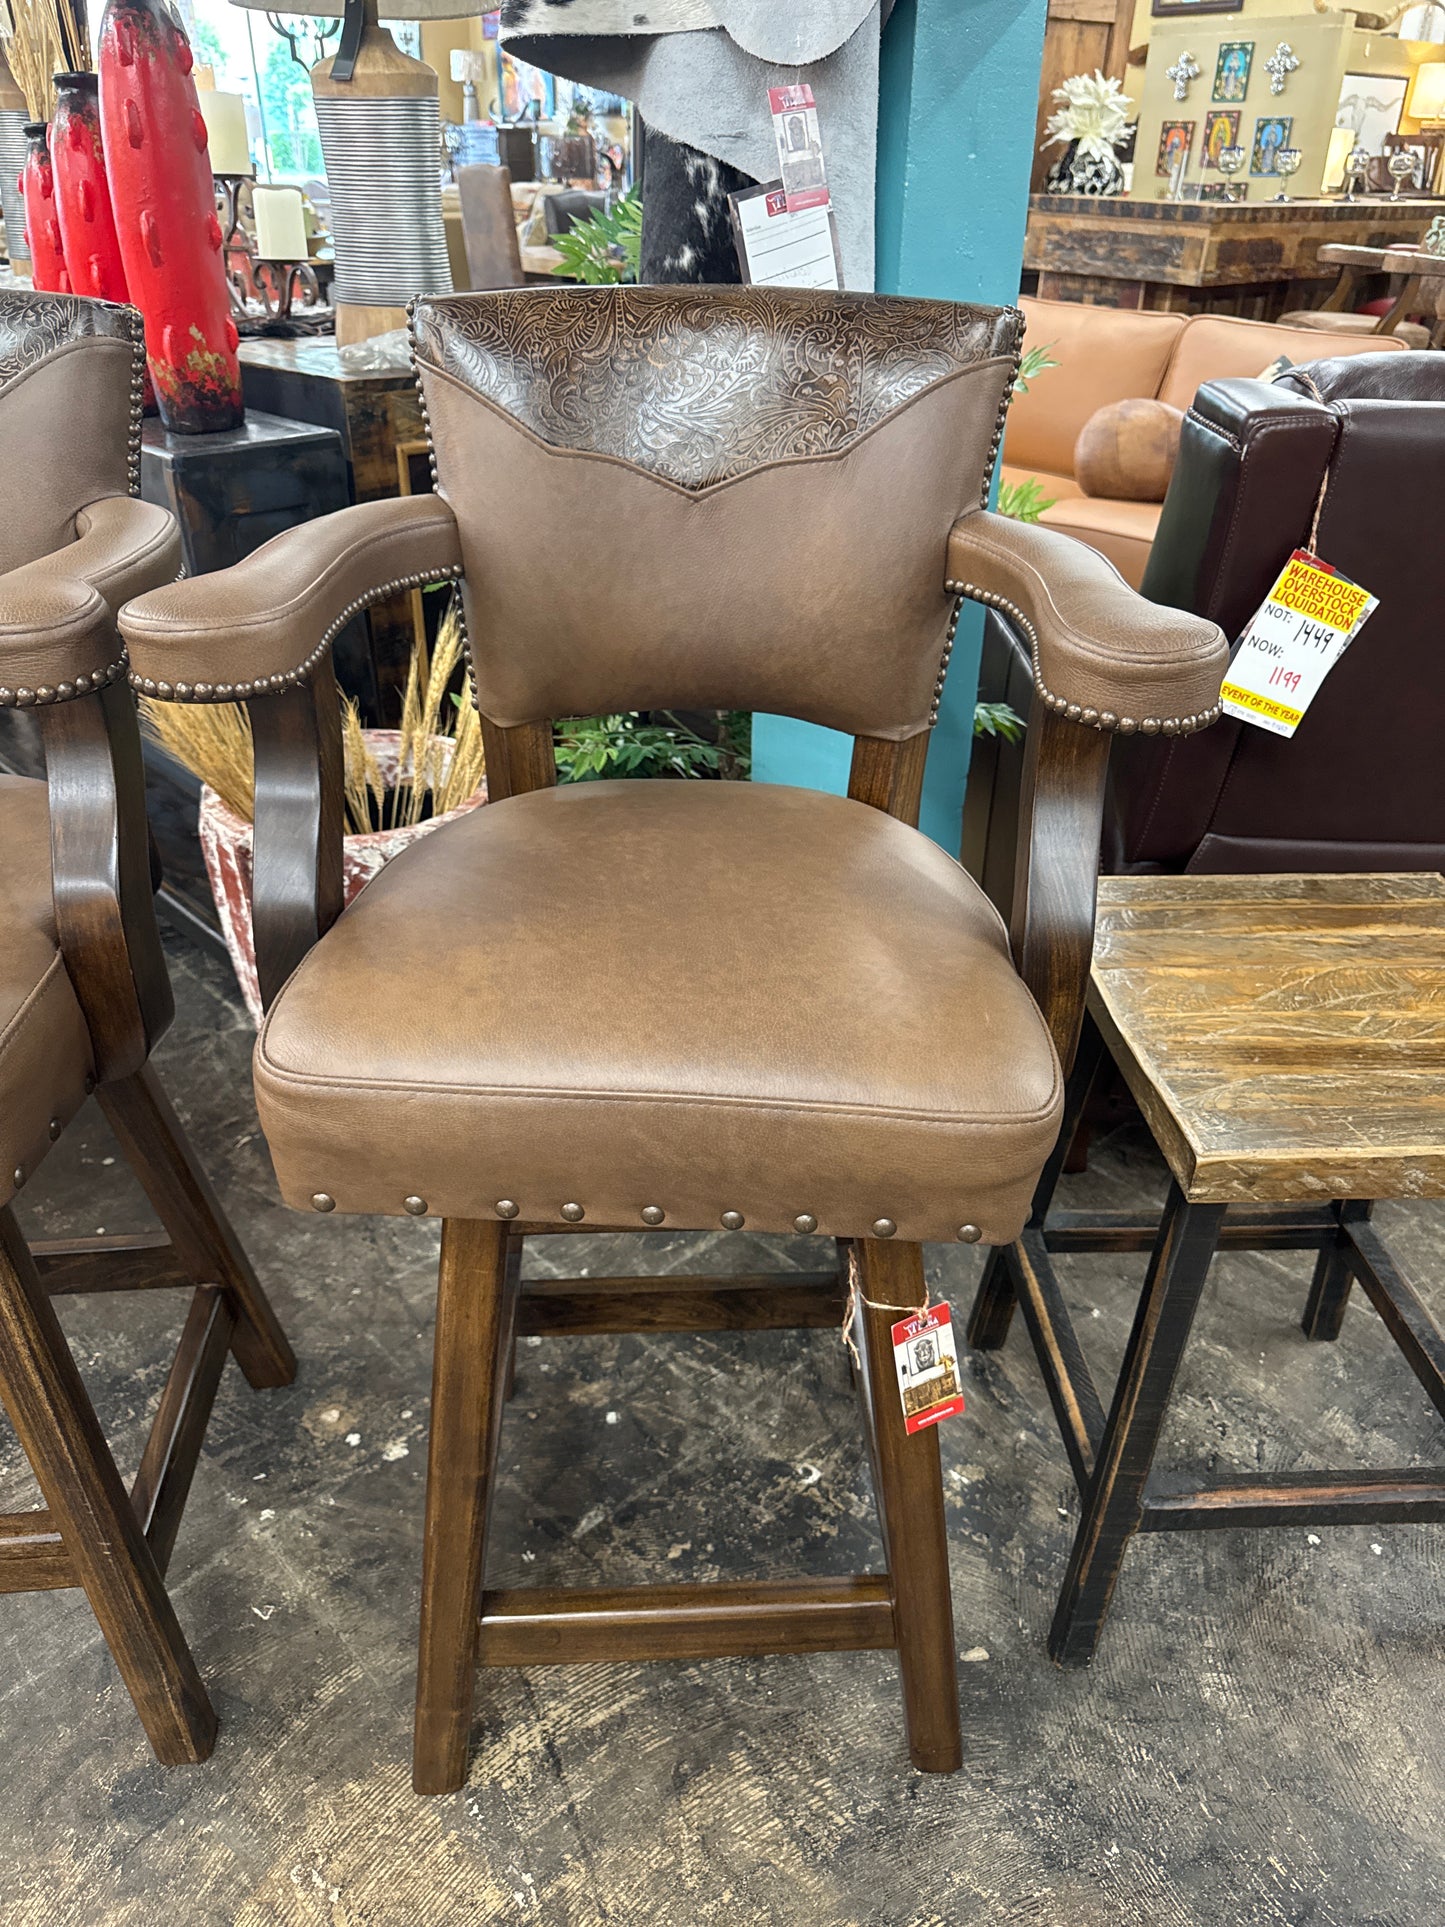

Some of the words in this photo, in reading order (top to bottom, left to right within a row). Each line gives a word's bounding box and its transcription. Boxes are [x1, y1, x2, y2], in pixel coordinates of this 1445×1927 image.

[1283, 577, 1359, 618] OVERSTOCK
[1288, 563, 1368, 608] WAREHOUSE
[1264, 603, 1294, 624] NOT:
[1292, 618, 1335, 655] 1449
[1273, 587, 1354, 631] LIQUIDATION
[1247, 635, 1285, 659] NOW:
[1268, 665, 1303, 693] 1199
[1221, 684, 1250, 704] EVENT
[1251, 697, 1263, 709] OF
[1263, 702, 1280, 716] THE
[1279, 708, 1300, 723] YEAR
